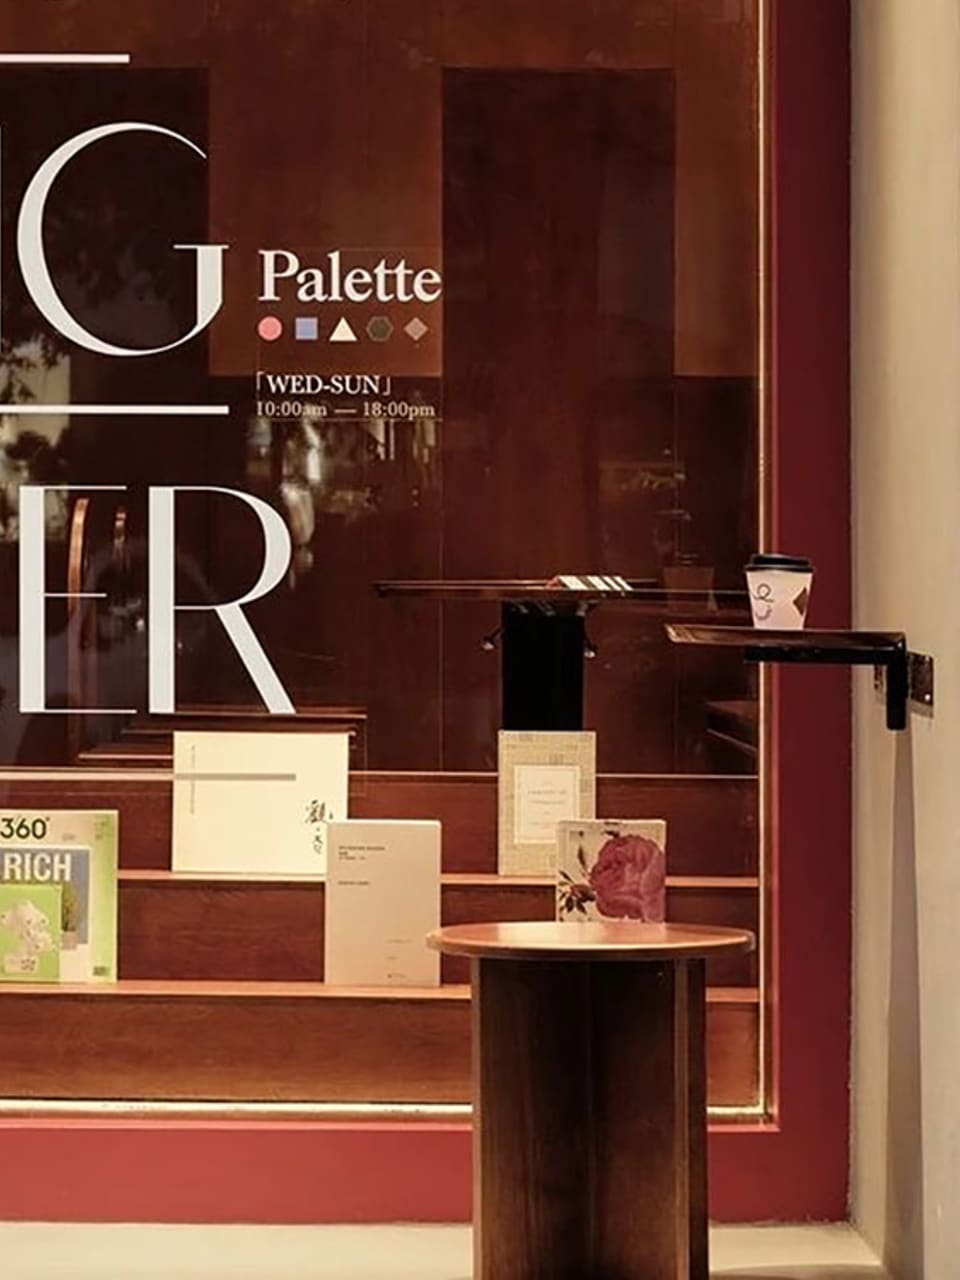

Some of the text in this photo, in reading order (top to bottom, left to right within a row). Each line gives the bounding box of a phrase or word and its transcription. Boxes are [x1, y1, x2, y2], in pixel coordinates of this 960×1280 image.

[258, 250, 442, 302] Palette
[363, 401, 435, 420] 18:00pm
[3, 852, 72, 882] RICH
